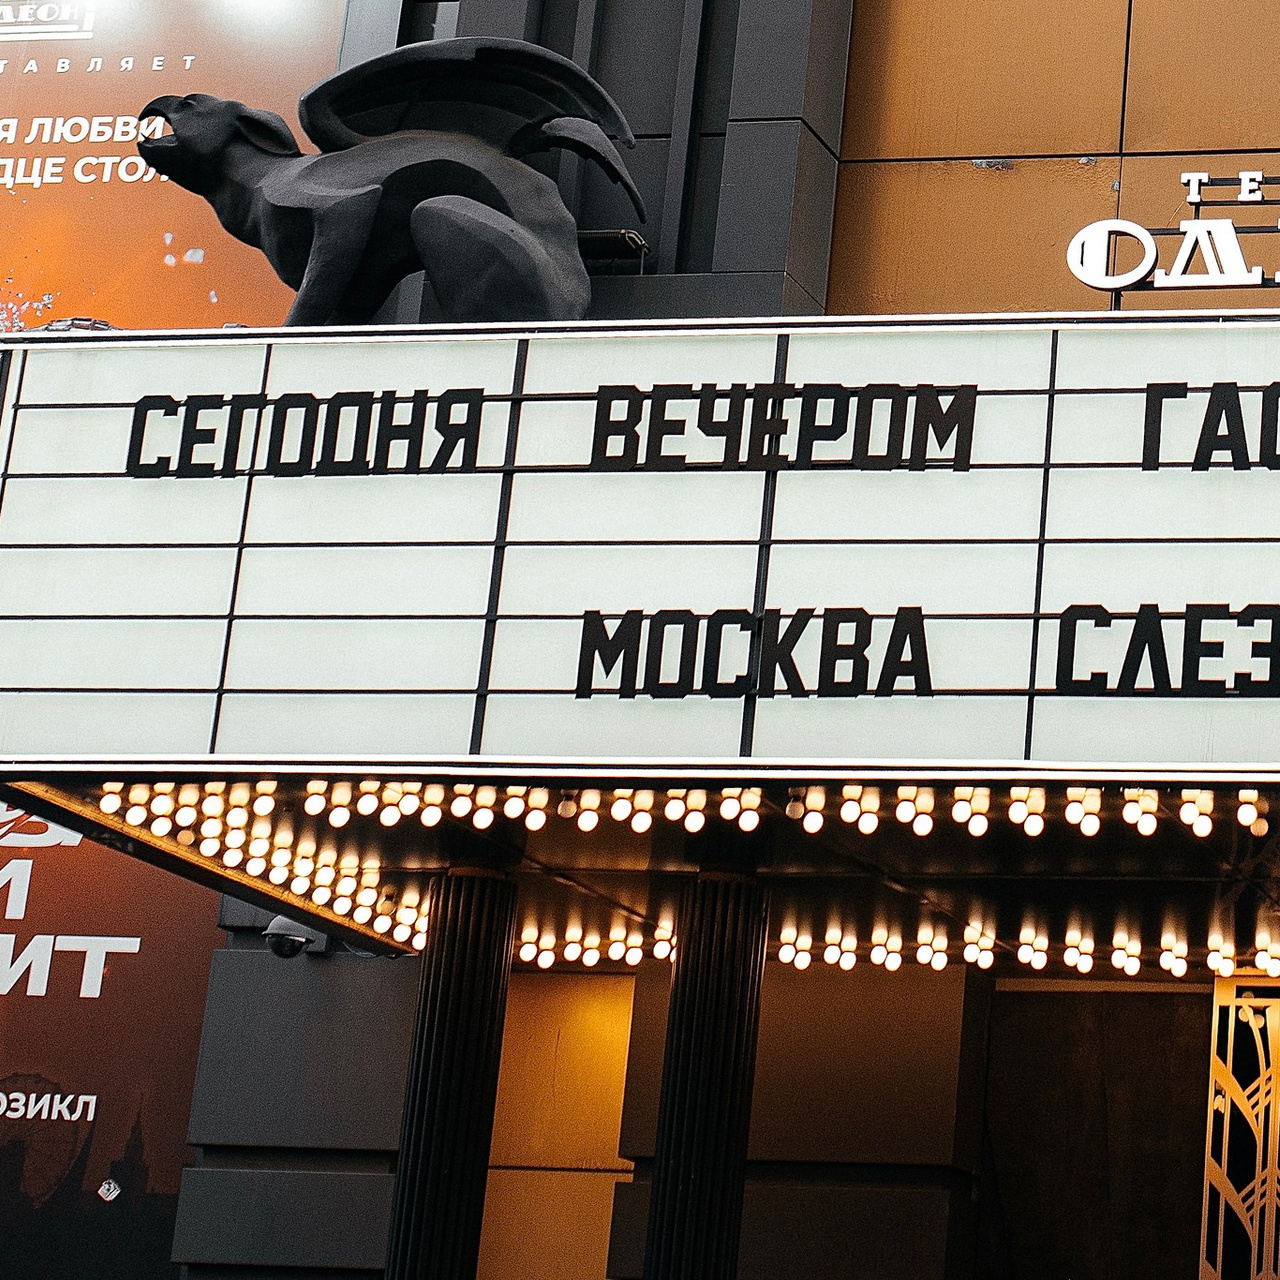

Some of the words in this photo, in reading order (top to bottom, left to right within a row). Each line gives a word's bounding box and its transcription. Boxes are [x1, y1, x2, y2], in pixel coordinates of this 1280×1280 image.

[24, 116, 166, 144] ЛЮБВИ
[125, 388, 485, 479] СЕГОДНЯ
[592, 384, 978, 472] ВЕЧЕРОМ
[575, 607, 934, 700] МОСКВА
